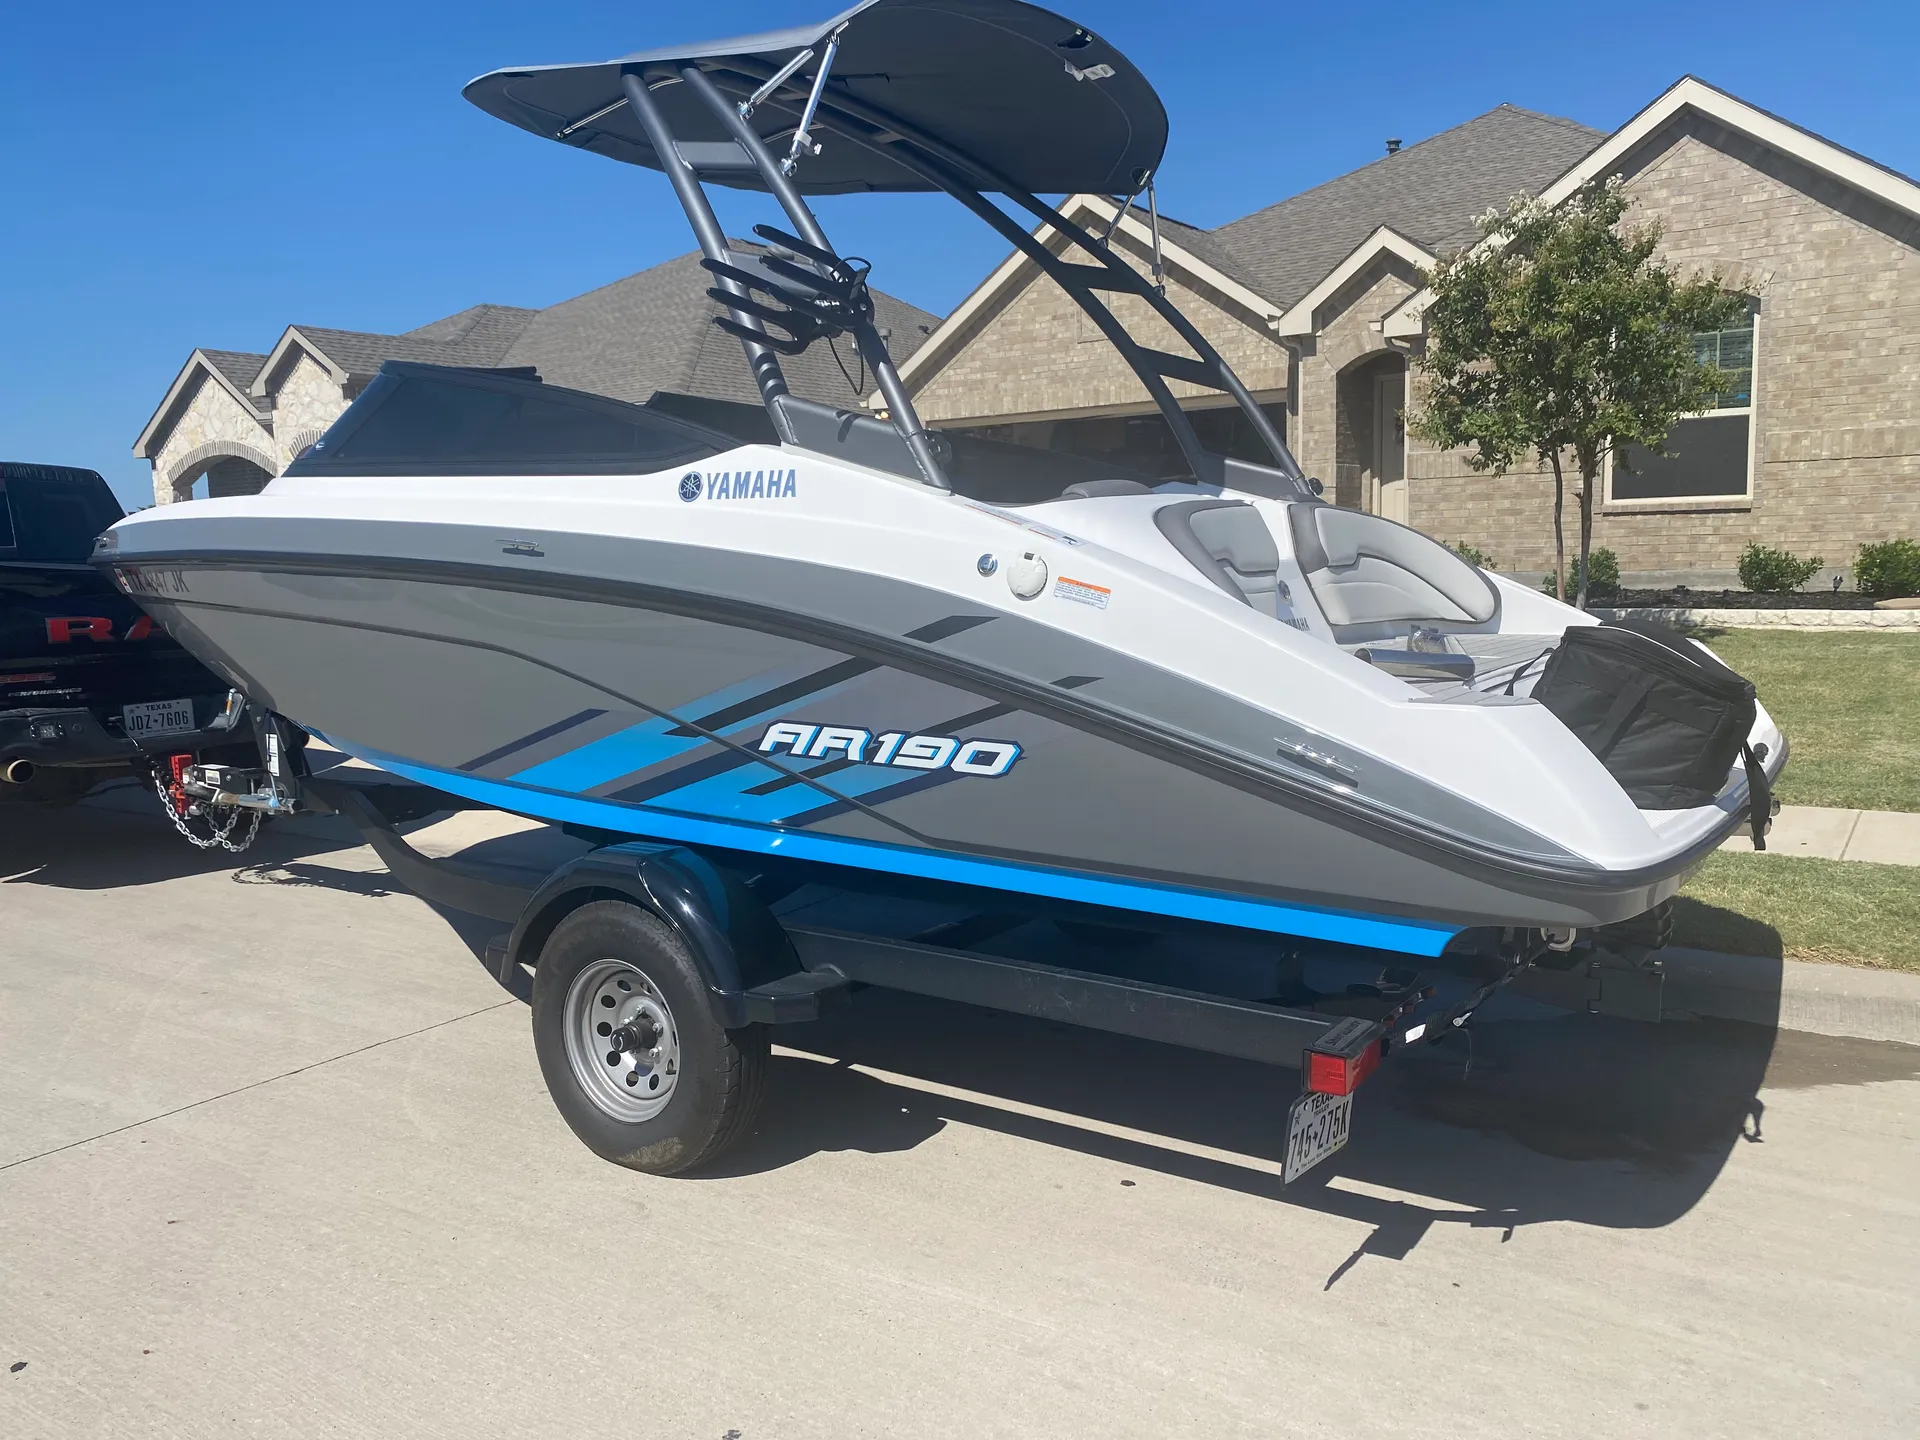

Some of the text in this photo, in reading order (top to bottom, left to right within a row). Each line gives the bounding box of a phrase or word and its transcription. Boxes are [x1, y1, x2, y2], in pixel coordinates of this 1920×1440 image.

[707, 469, 797, 500] YAMAHA
[171, 569, 190, 593] JK
[45, 616, 164, 645] RA
[129, 714, 152, 731] JDZ
[158, 710, 189, 728] 7606
[145, 703, 172, 712] TEXAS
[757, 721, 1022, 777] AR190
[1313, 1104, 1330, 1118] TRAILER
[1289, 1100, 1349, 1170] 745 275K
